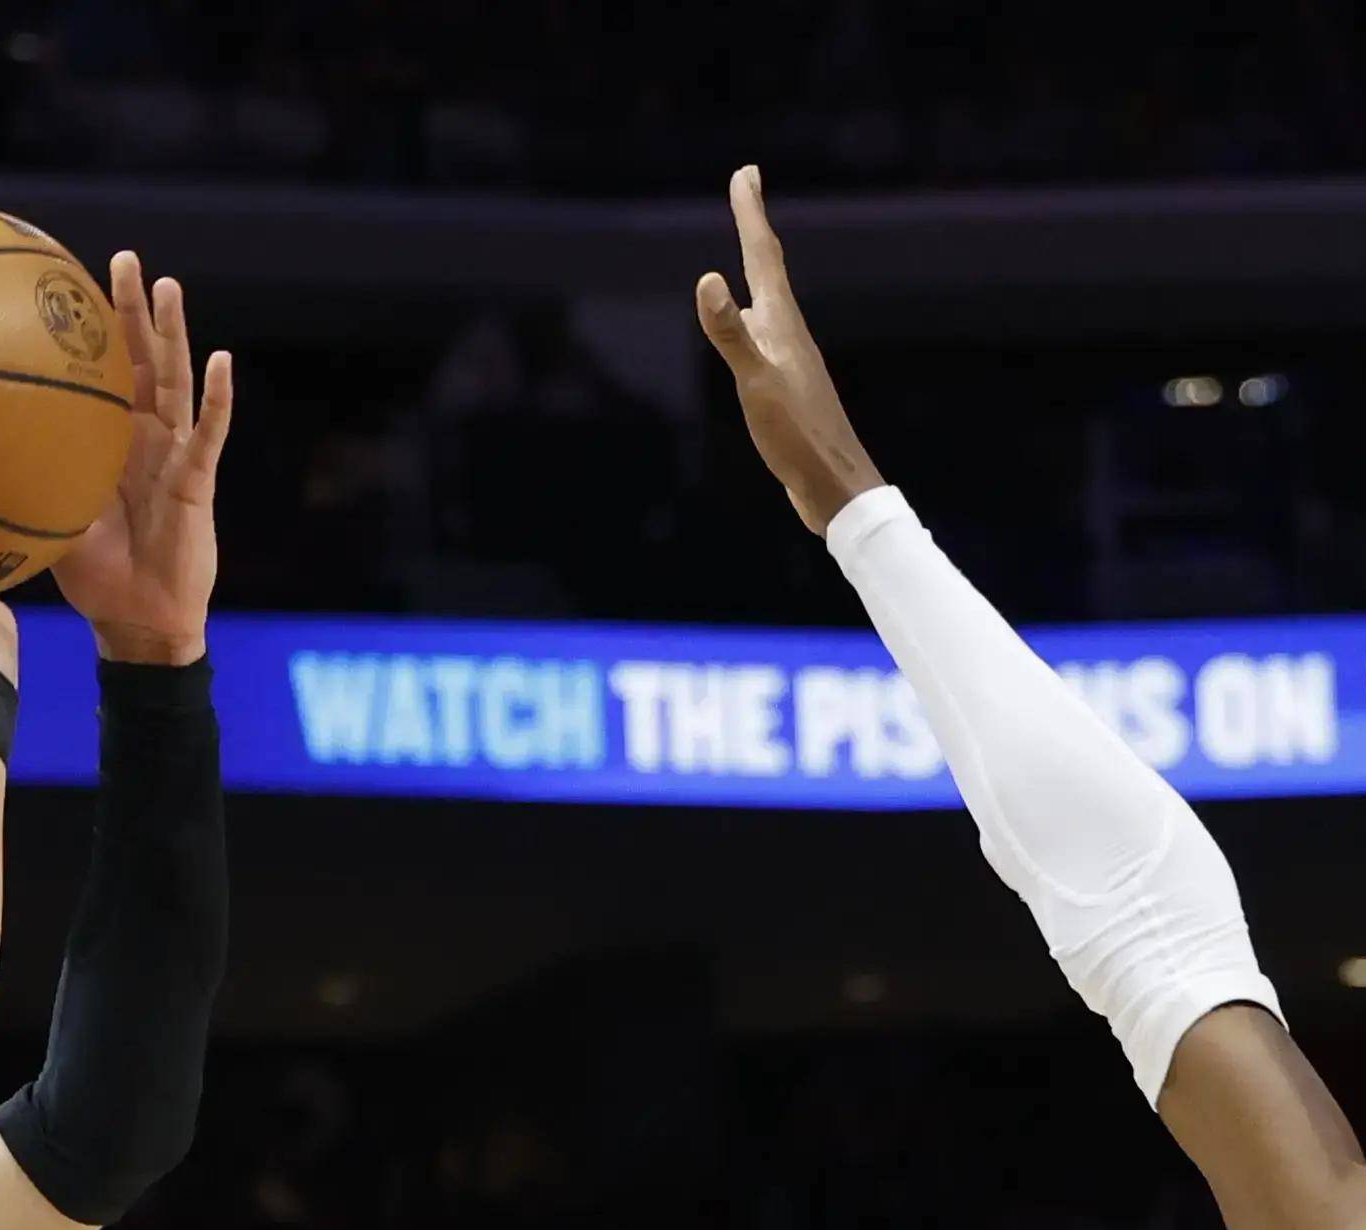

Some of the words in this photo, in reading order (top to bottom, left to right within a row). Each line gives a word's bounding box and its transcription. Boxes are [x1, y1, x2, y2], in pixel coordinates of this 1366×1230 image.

[288, 650, 605, 770] WATCH
[609, 660, 794, 777] THE
[1193, 652, 1340, 769] ON
